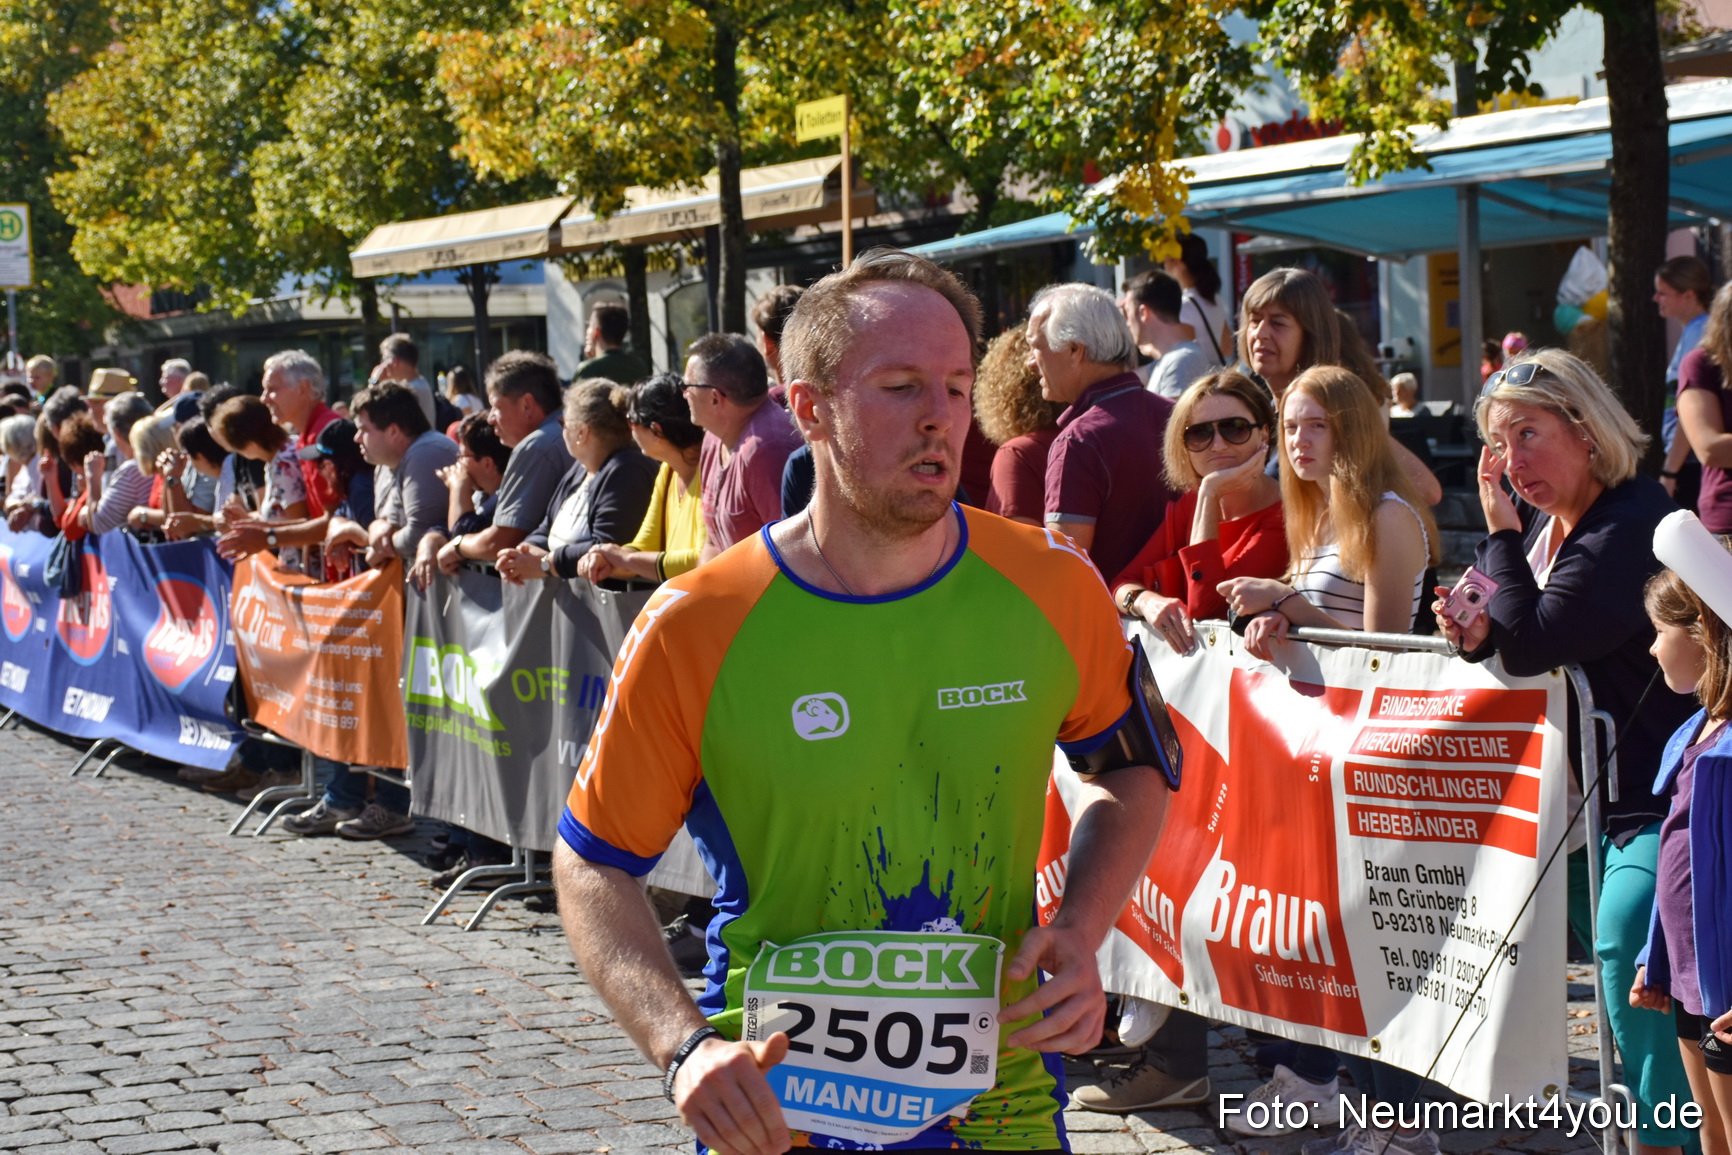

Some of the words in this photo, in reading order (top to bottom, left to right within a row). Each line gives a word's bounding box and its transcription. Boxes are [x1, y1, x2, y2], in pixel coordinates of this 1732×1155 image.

[806, 111, 842, 128] Toiletten
[939, 681, 1026, 709] BOCK
[1378, 695, 1466, 716] BINDESTRICKE
[1361, 731, 1511, 758] VERZURRSYSTEME
[1309, 753, 1321, 782] Seit
[1353, 770, 1502, 800] RUNDSCHLINGEN
[1208, 812, 1221, 833] Seit
[1216, 783, 1228, 812] 1929
[1357, 811, 1479, 839] HEBEBÄNDER
[1364, 860, 1410, 883] Braun
[1415, 864, 1466, 886] GmbH
[1205, 850, 1335, 967] Braun
[1369, 886, 1393, 907] Am
[1397, 888, 1467, 919] Grünberg
[1471, 896, 1477, 916] 8
[1372, 911, 1435, 935] D-92318
[767, 941, 979, 990] BOCK
[1380, 946, 1409, 967] Tel.
[1412, 949, 1447, 977] 09181
[1255, 964, 1293, 988] Sicher
[1297, 972, 1315, 990] ist
[1318, 977, 1358, 1000] sicher
[1386, 971, 1413, 993] Fax
[1416, 975, 1446, 1003] 09181
[978, 1016, 990, 1029] C
[777, 1001, 969, 1075] 2505
[784, 1075, 938, 1122] MANUEL
